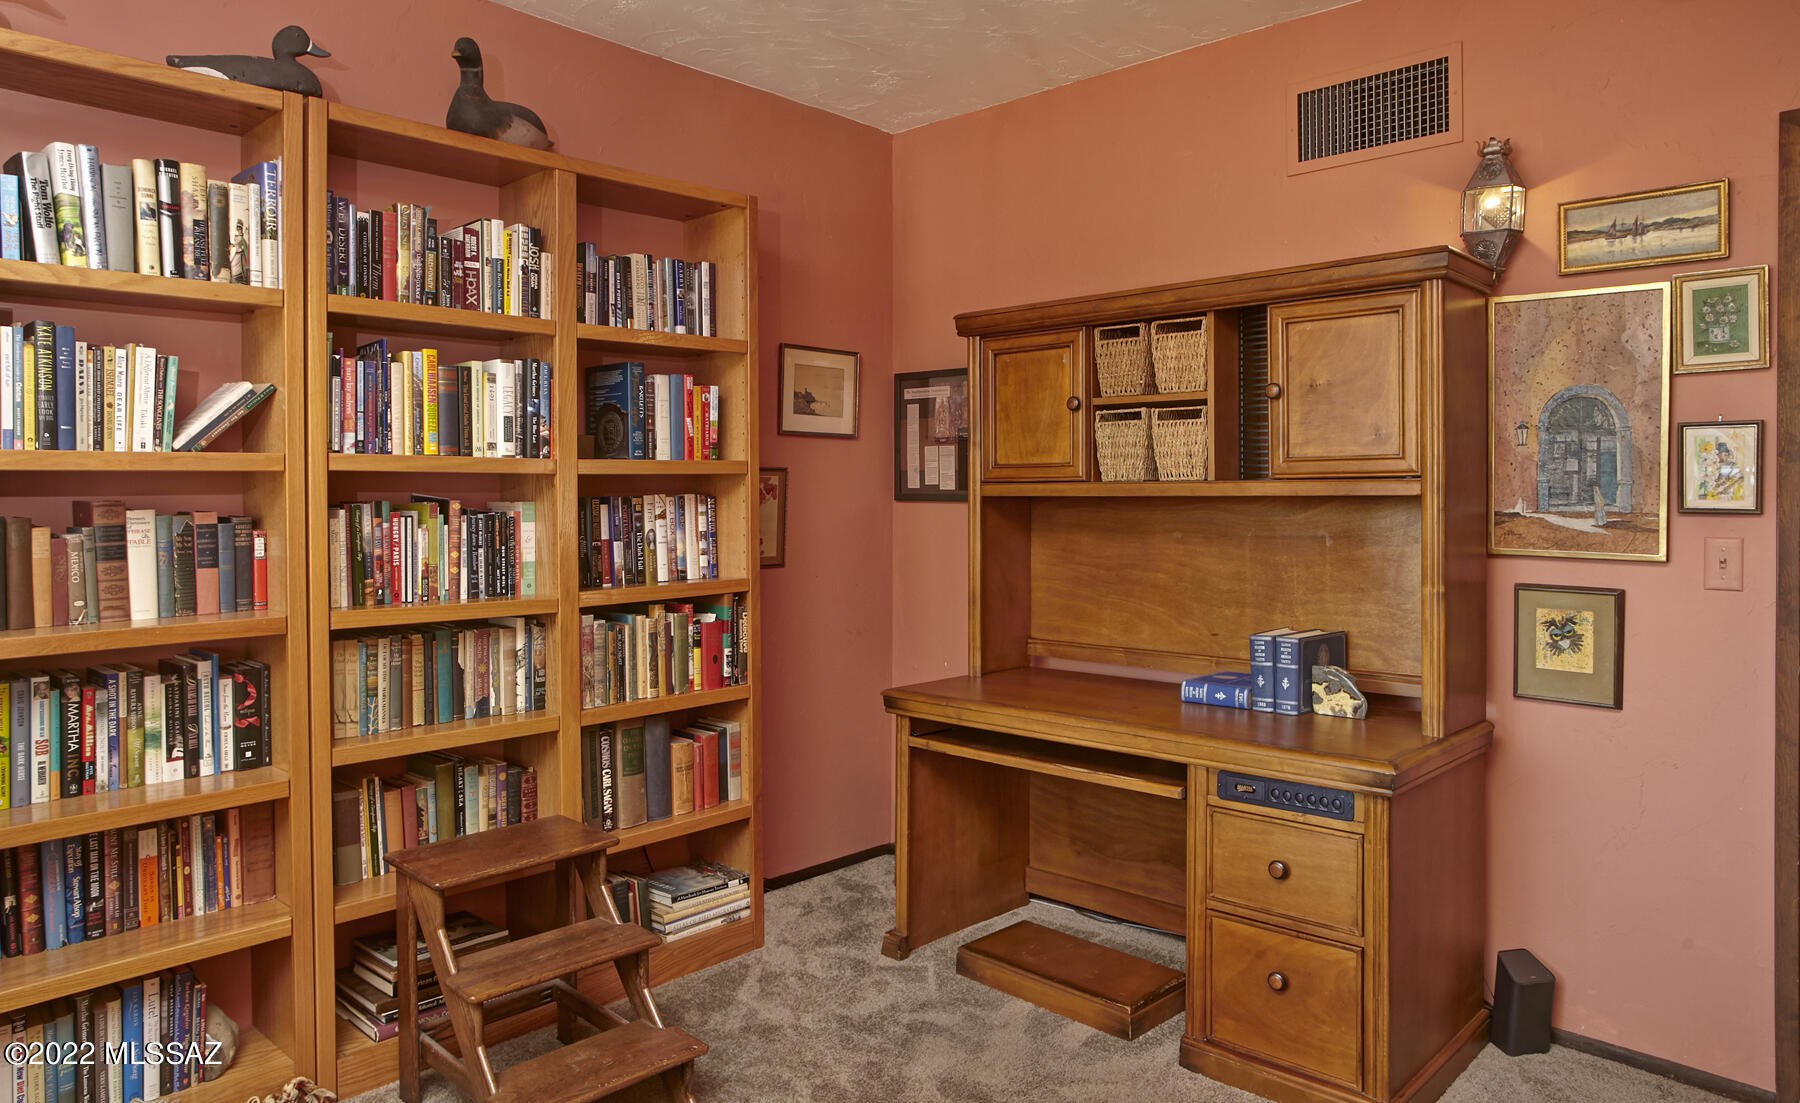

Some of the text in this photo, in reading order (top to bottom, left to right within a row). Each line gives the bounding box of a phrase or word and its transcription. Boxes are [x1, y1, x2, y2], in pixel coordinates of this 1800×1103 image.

[31, 192, 41, 210] Right
[39, 180, 54, 228] Tom Wolfe
[266, 170, 276, 231] TERROIR
[338, 201, 348, 264] WET DESERT
[529, 243, 540, 270] JOSH
[372, 263, 381, 290] Them
[466, 271, 477, 305] HOAX
[36, 325, 52, 391] KATE ATKINSON
[427, 354, 436, 372] CARL
[106, 369, 114, 398] ISHMAEL
[116, 370, 124, 387] Munro
[427, 372, 437, 403] HIAASEN
[503, 386, 513, 415] LEGACY
[427, 403, 437, 432] SQUEEZE
[70, 551, 80, 583] MEXICO
[35, 739, 49, 756] SOB
[67, 704, 79, 781] MARTHA INC.
[601, 736, 613, 814] COSMOS CARL SAGAN
[89, 838, 98, 850] LAST
[90, 851, 98, 862] MAN
[91, 871, 99, 881] THE
[111, 861, 119, 879] STILL
[91, 882, 99, 897] MOON
[72, 900, 82, 917] Alsop
